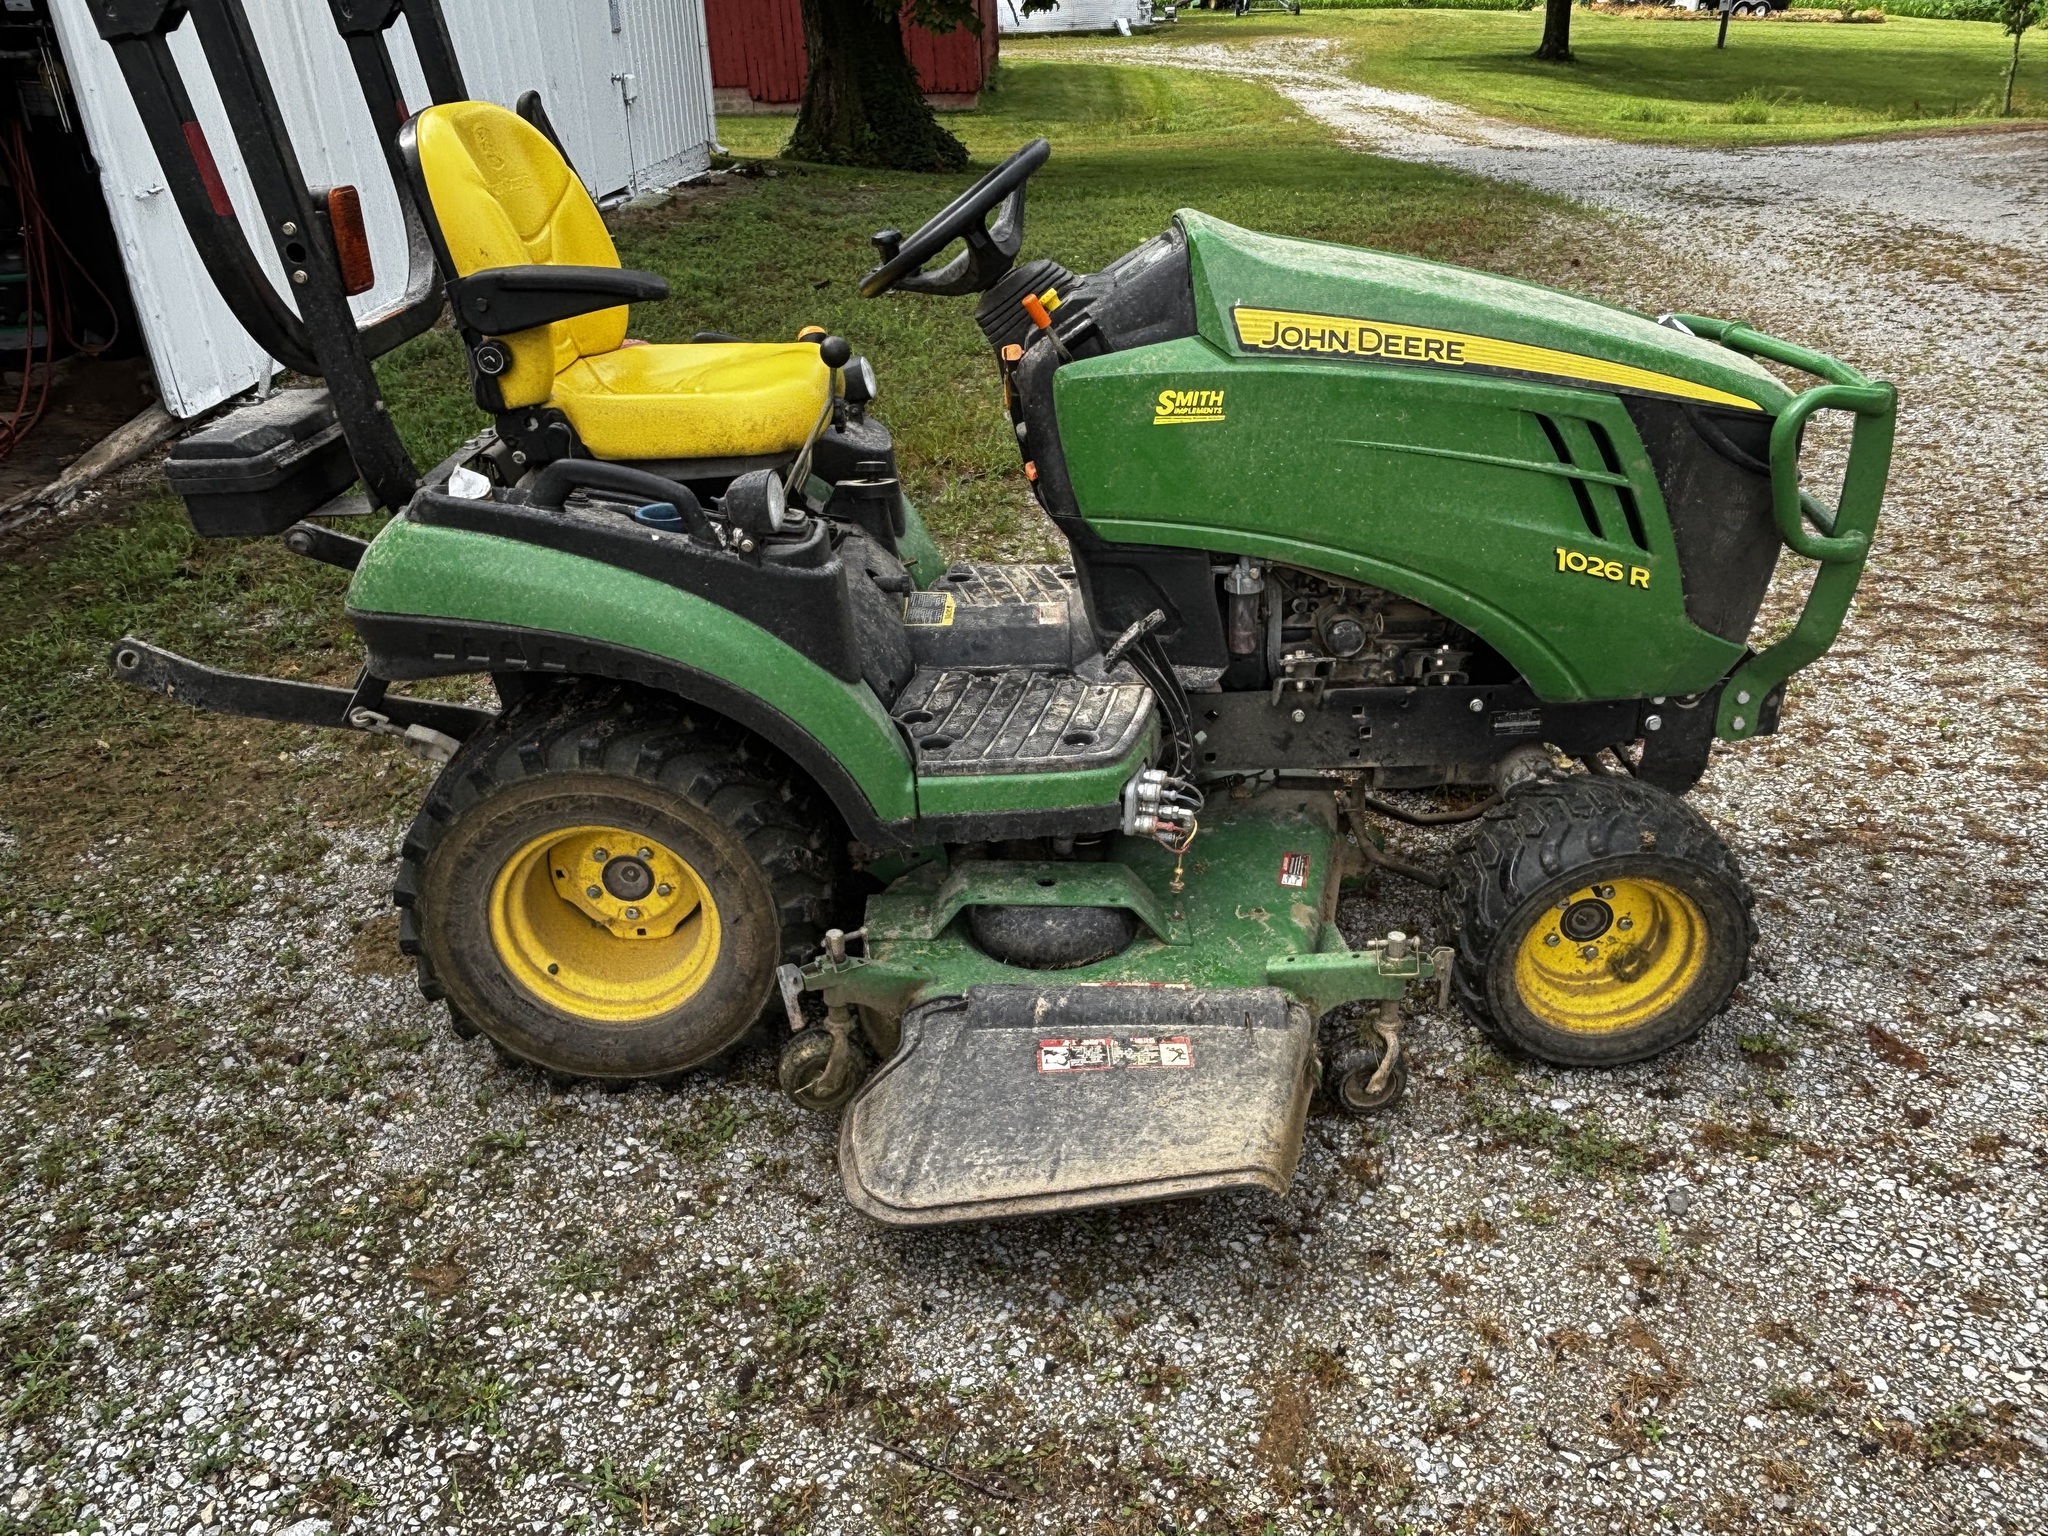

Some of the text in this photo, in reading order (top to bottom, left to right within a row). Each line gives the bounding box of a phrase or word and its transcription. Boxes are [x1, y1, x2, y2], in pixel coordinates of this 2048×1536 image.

[1262, 321, 1464, 361] JOHN DEERE
[1155, 390, 1225, 415] SMITH
[1556, 547, 1651, 589] 1026 R
